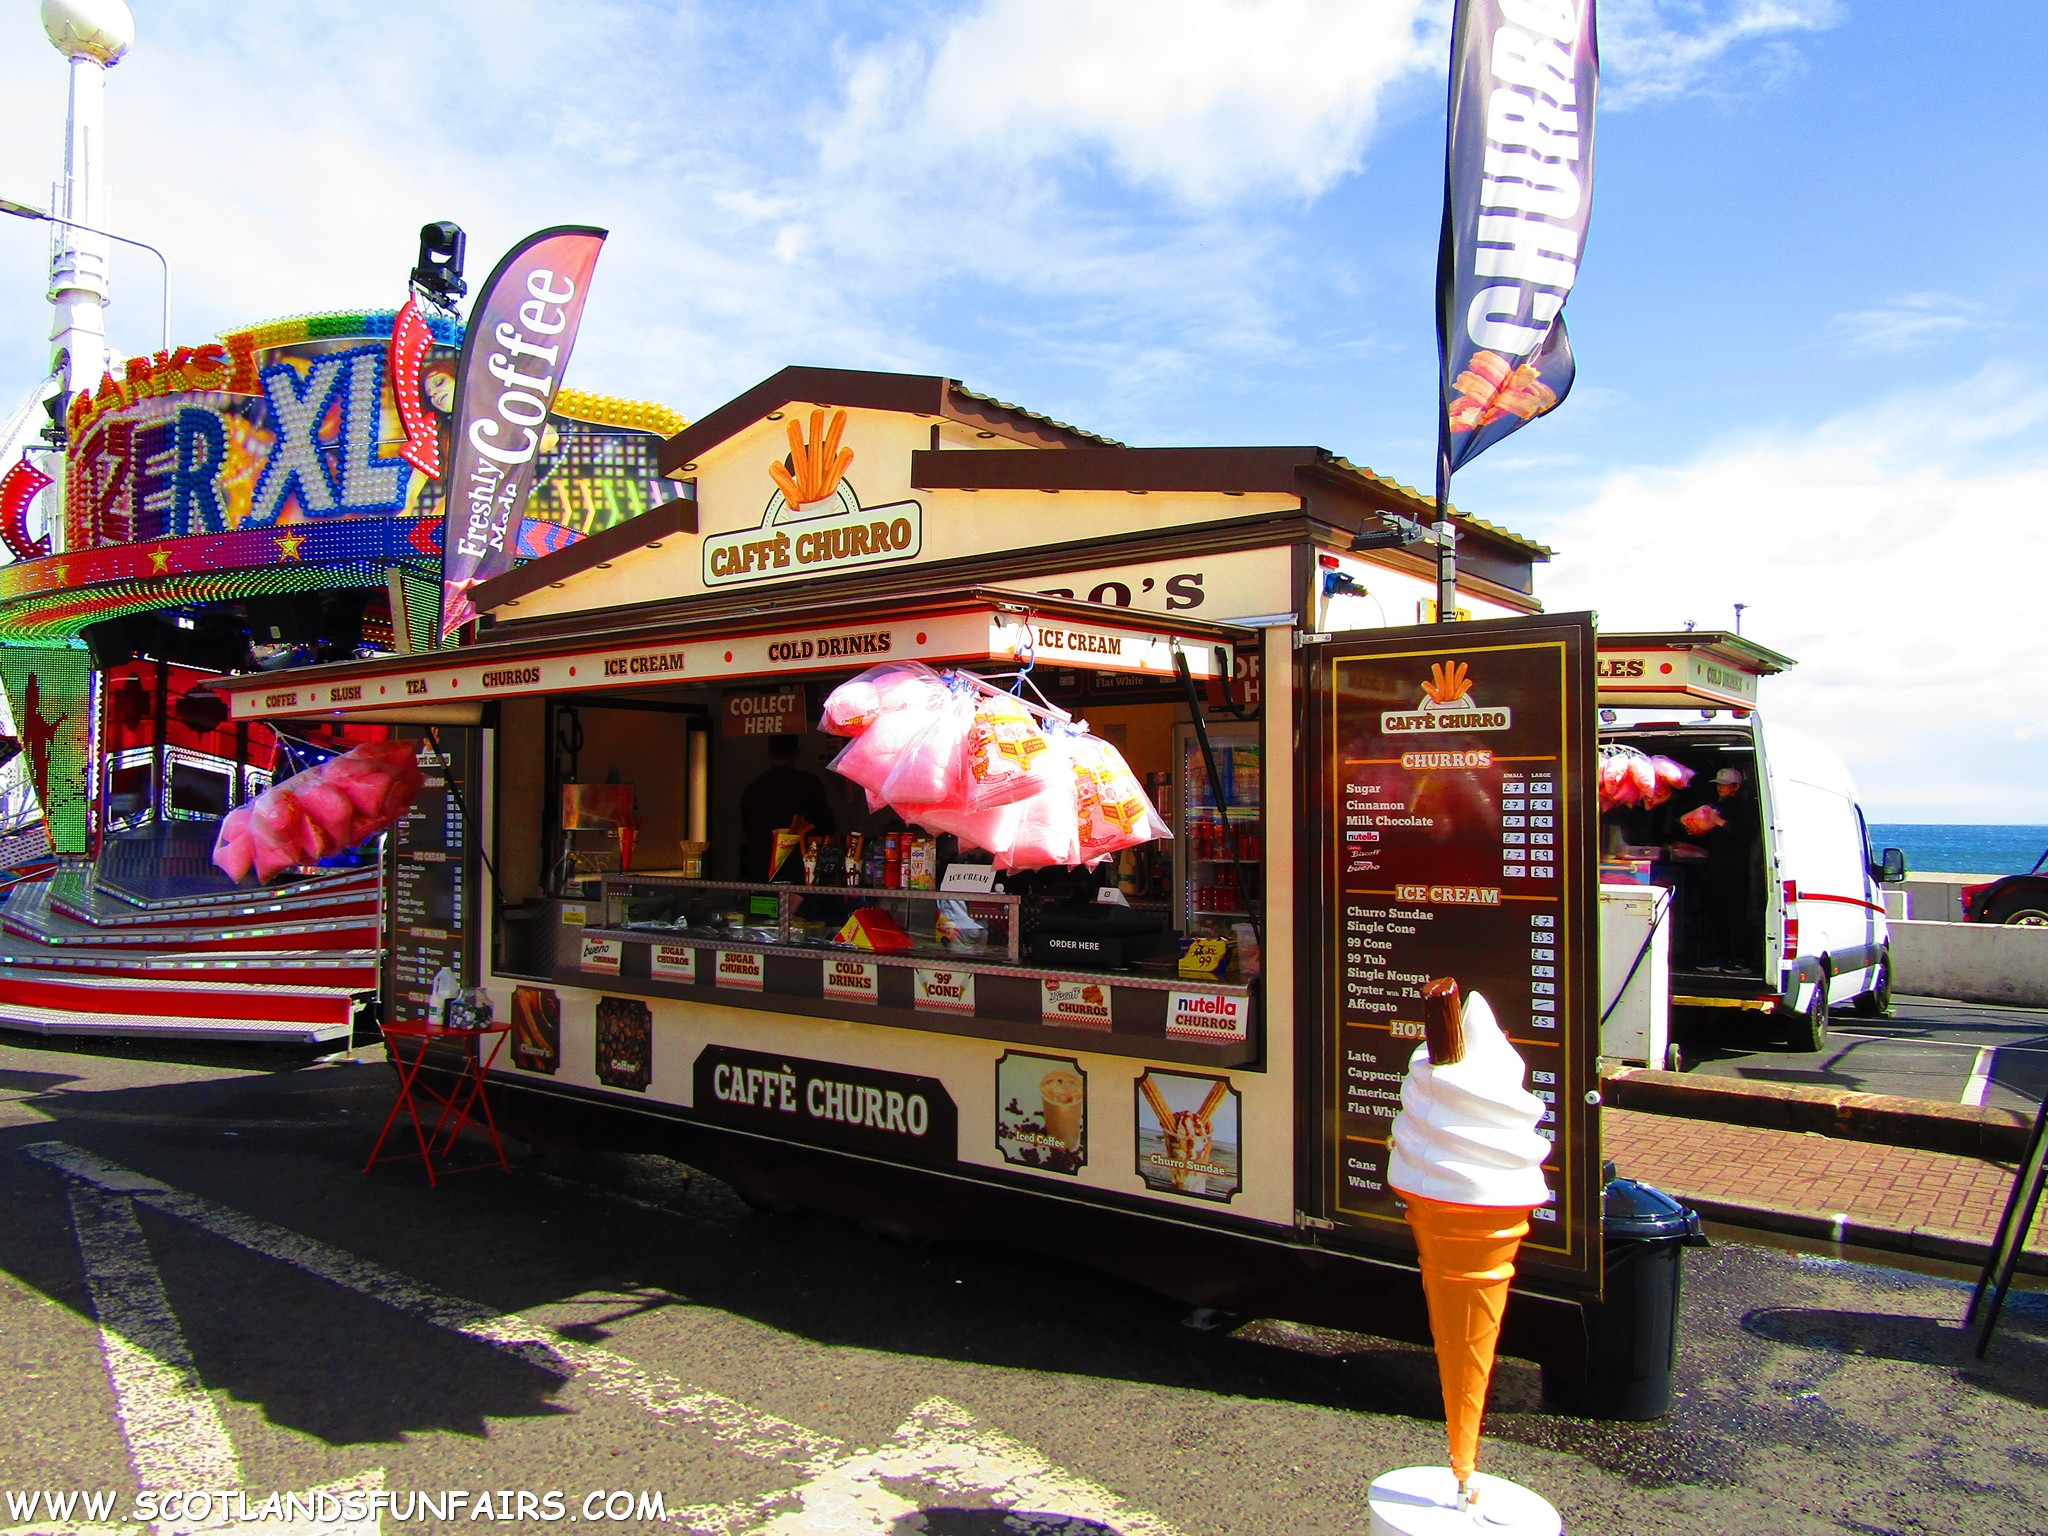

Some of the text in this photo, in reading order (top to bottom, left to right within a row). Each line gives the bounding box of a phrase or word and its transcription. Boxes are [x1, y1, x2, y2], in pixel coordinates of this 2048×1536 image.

[470, 267, 576, 465] Coffee
[457, 459, 506, 560] Freshly
[489, 481, 519, 553] Made
[710, 516, 912, 577] CAFFÈ CHURRO
[768, 631, 891, 662] COLD DRINKS
[1037, 628, 1122, 656] ICE CREAM
[604, 653, 684, 676] ICE CREAM
[482, 667, 540, 687] CHURROS
[1116, 676, 1144, 687] White
[330, 685, 361, 702] SLUSH
[406, 678, 428, 695] TEA
[265, 692, 297, 708] COFFEE
[730, 694, 796, 716] COLLECT
[744, 715, 784, 735] HERE
[1385, 712, 1506, 730] CAFFÈ CHURRO
[1402, 752, 1492, 768] CHURROS
[1346, 783, 1381, 796] Sugar
[1346, 800, 1404, 811] Cinnamon
[1346, 816, 1434, 827] Milk Chocolate
[1348, 832, 1378, 841] nutella
[949, 872, 989, 884] ICE CREAM
[1397, 886, 1499, 904] ICE CREAM
[1347, 907, 1433, 920] Churro Sundae
[1347, 921, 1416, 934] Single Cone
[584, 944, 610, 957] bueno
[661, 946, 685, 957] SUGAR
[1049, 939, 1100, 951] ORDER HERE
[1347, 938, 1392, 950] 99 Cone
[657, 955, 689, 966] CHURROS
[725, 952, 755, 965] SUGAR
[1199, 956, 1212, 968] 99
[1347, 953, 1386, 965] 99 Tub
[719, 963, 760, 976] CHURROS
[835, 962, 864, 975] COLD
[1347, 968, 1430, 983] Single Nougat
[829, 975, 871, 989] DRINKS
[927, 983, 960, 998] CONE
[1049, 987, 1080, 1003] Biscoff
[1347, 983, 1384, 997] Oyster
[1401, 987, 1423, 999] Fla
[1058, 1002, 1108, 1016] CHURROS
[1177, 996, 1237, 1015] nutella
[1348, 999, 1398, 1013] Affogato
[1175, 1014, 1236, 1031] CHURROS
[520, 1043, 551, 1058] Churro's
[1347, 1051, 1376, 1063] Latte
[611, 1059, 637, 1073] Coffee
[713, 1062, 929, 1136] CAFFÈ CHURRO
[1347, 1102, 1370, 1115] Flat
[1016, 1131, 1065, 1149] Iced Coffee
[1151, 1155, 1225, 1176] Churro Sundae
[1348, 1159, 1376, 1171] Cans
[1348, 1176, 1382, 1191] Water
